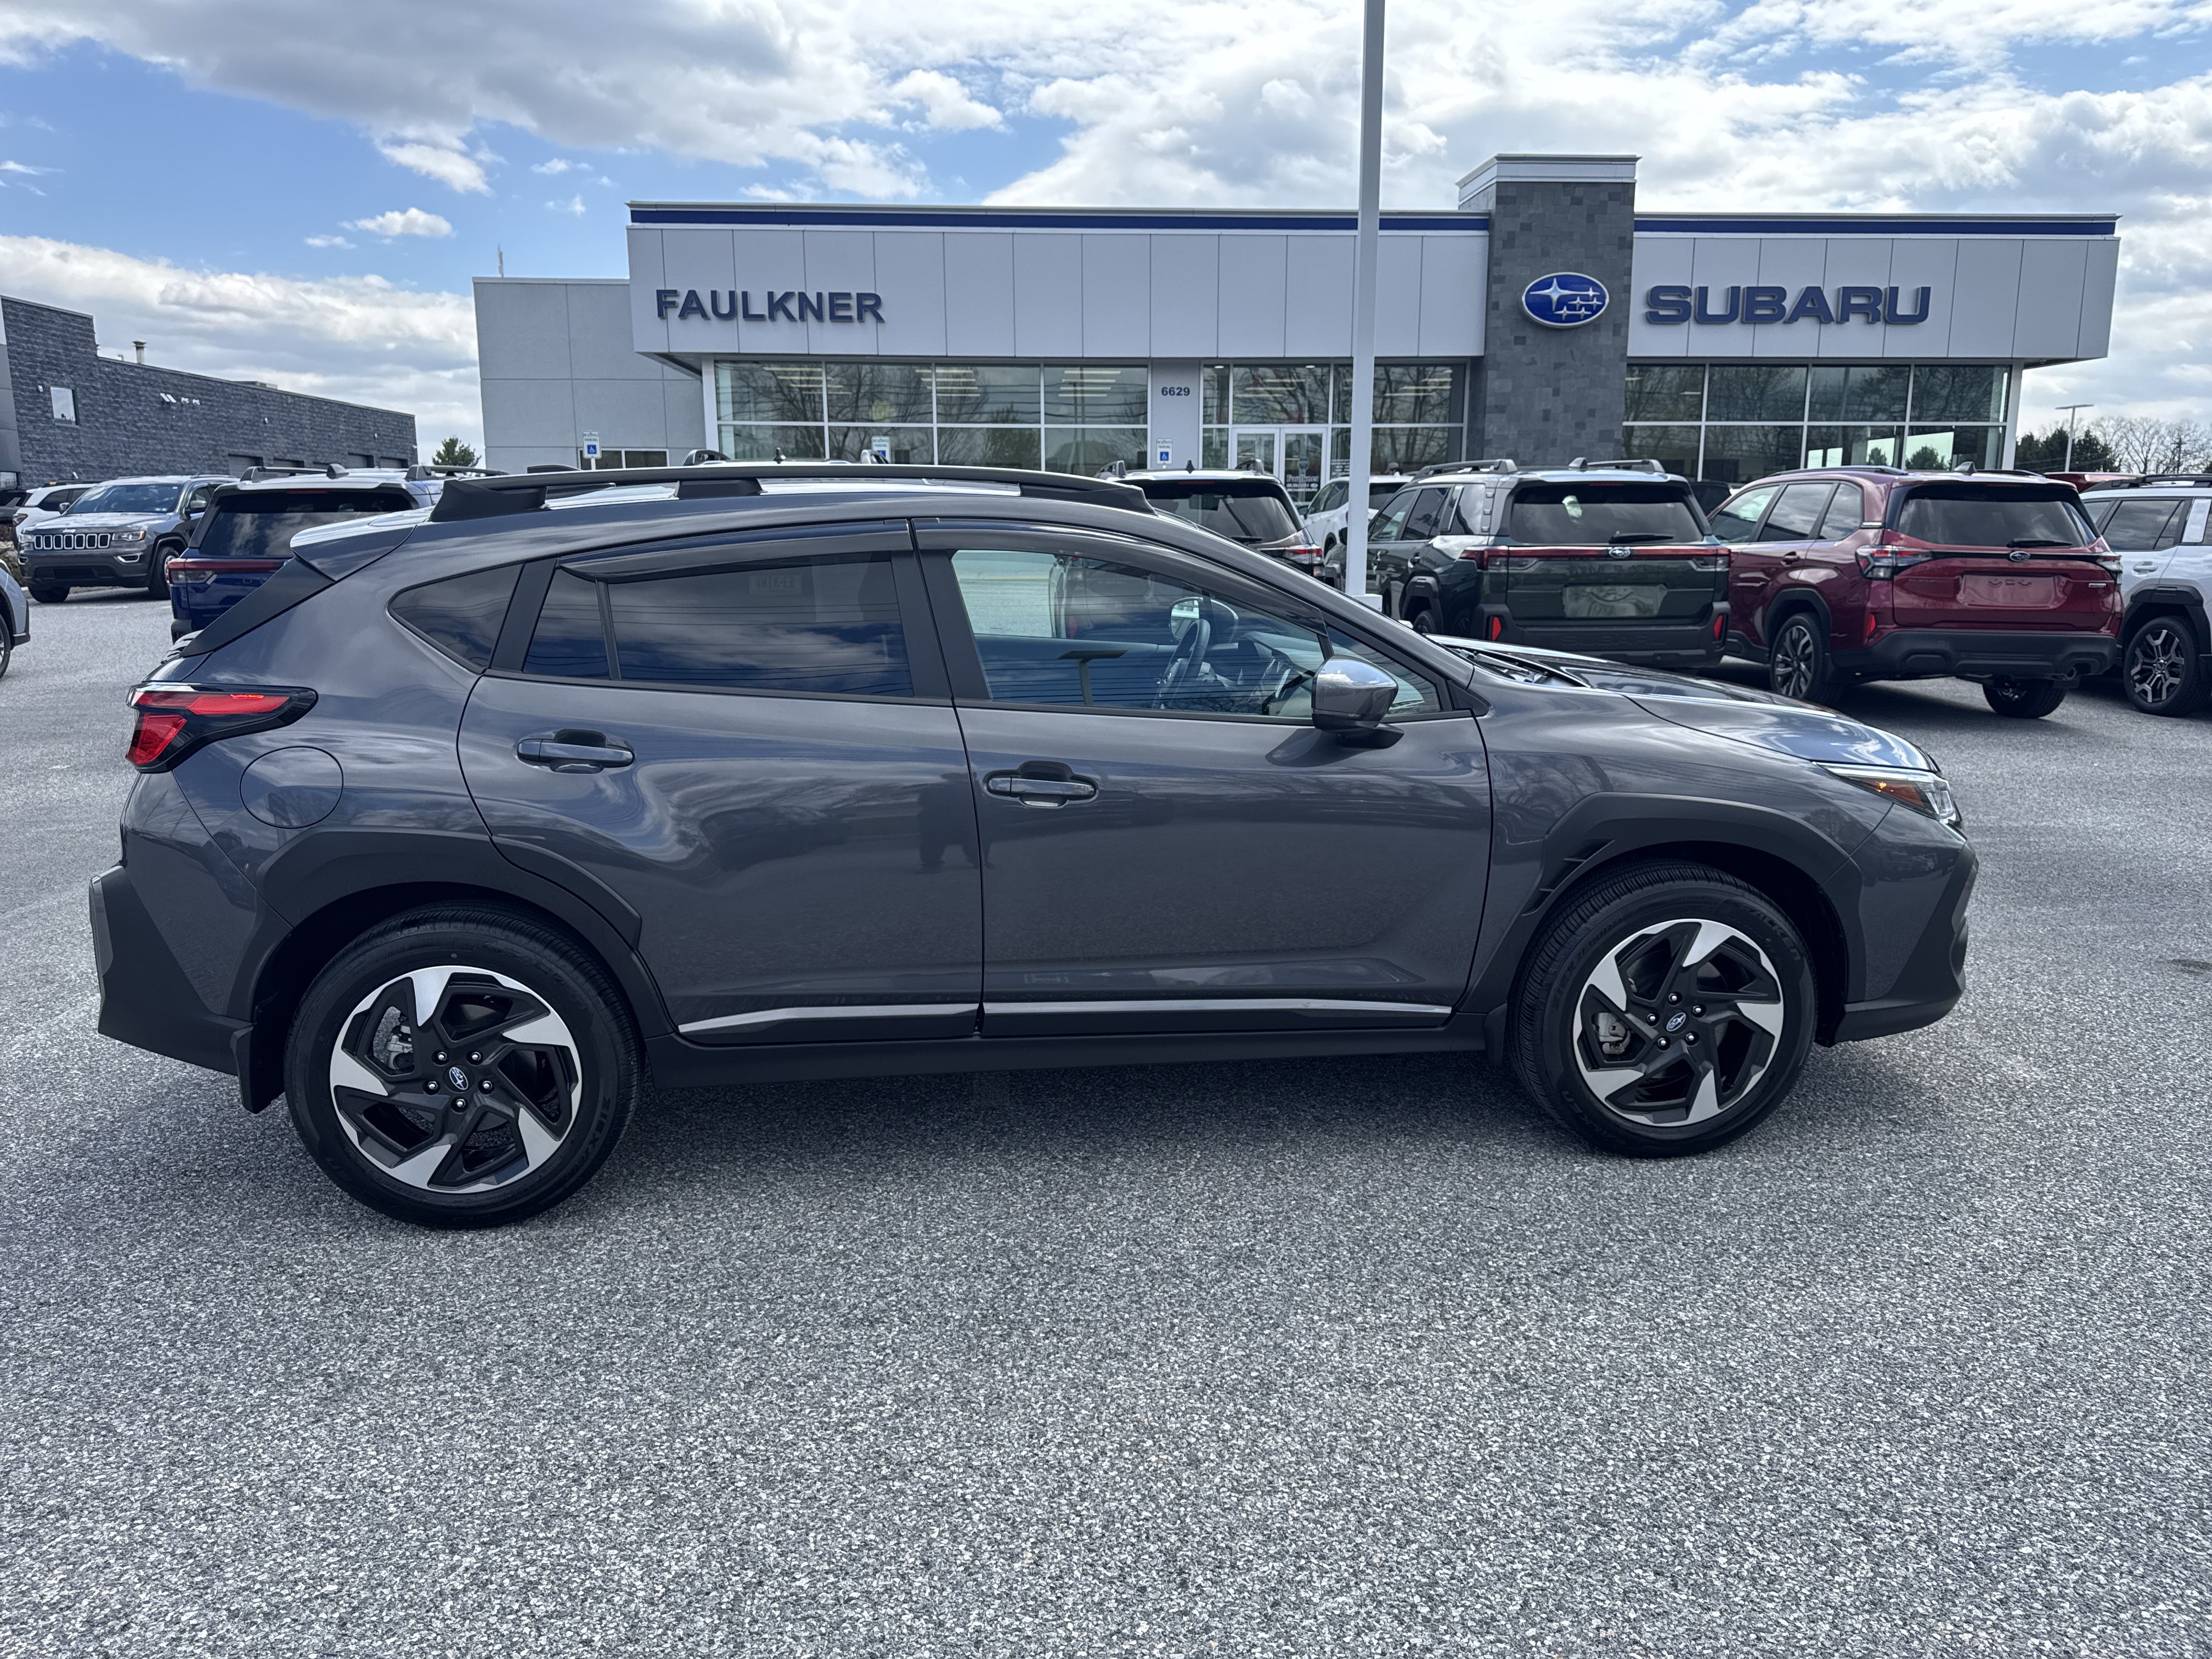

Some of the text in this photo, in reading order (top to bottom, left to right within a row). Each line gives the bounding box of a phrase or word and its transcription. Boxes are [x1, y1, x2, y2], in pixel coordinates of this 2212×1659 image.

[656, 289, 885, 323] FAULKNER
[1646, 285, 1932, 325] SUBARU
[1161, 387, 1190, 396] 6629
